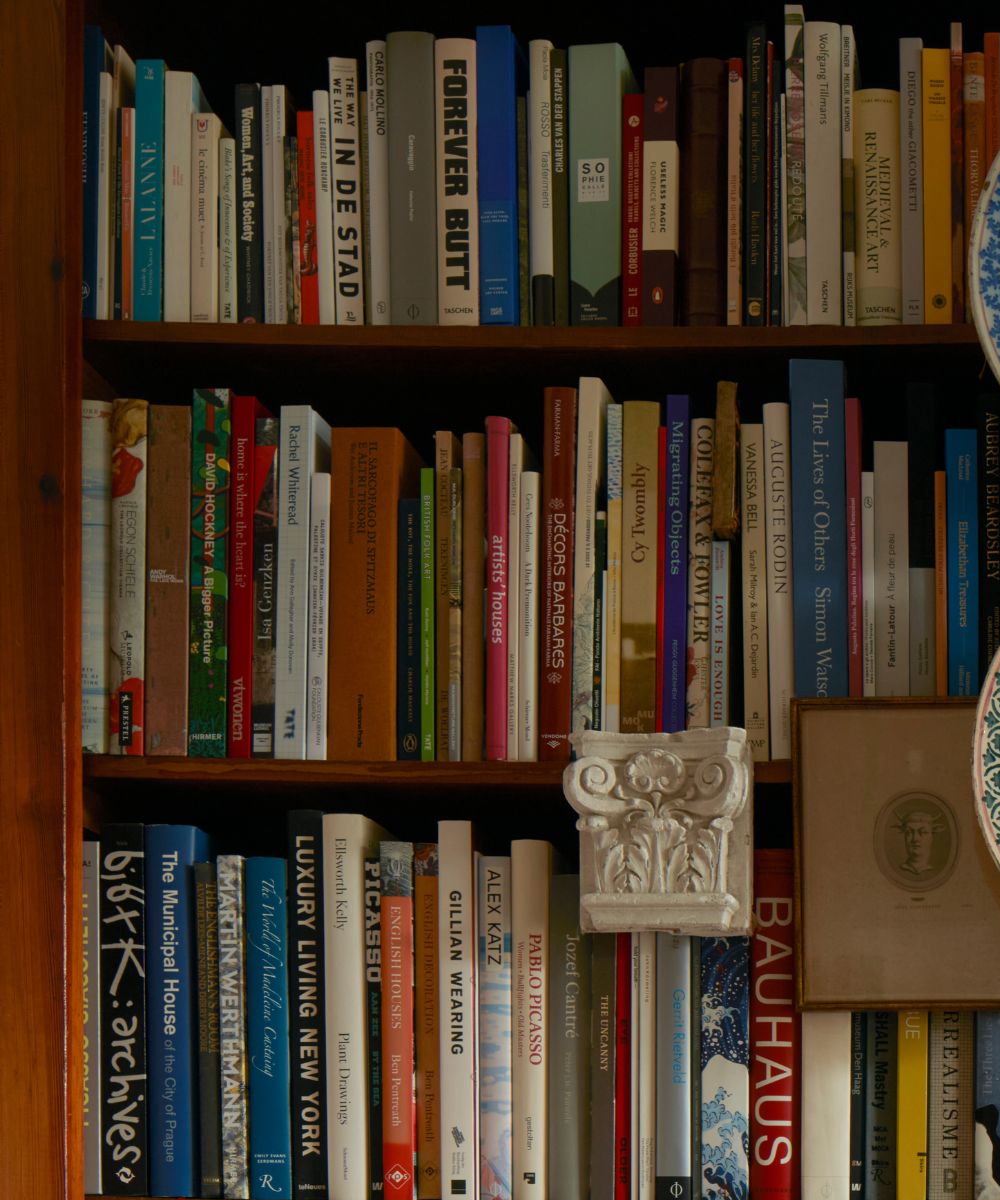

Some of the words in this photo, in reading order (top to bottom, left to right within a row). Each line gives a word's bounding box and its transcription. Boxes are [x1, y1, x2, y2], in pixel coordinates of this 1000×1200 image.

[375, 51, 384, 85] CARLO
[816, 33, 828, 80] Wolfgang
[333, 78, 342, 96] WE
[334, 100, 343, 124] LIVE
[345, 78, 354, 100] THE
[346, 103, 355, 126] WAY
[376, 89, 385, 135] MOLLINO
[820, 82, 829, 124] Tillmans
[444, 60, 468, 196] FOREVER
[540, 102, 550, 137] ROSSO
[335, 138, 355, 165] IN
[336, 180, 356, 213] DE
[864, 131, 878, 240] RENAISSANCE
[879, 156, 892, 235] MEDIEVAL
[338, 226, 359, 297] STAD
[446, 209, 470, 290] BUTT
[866, 242, 879, 273] ART
[879, 239, 890, 248] &
[288, 425, 300, 461] Rachel
[668, 421, 684, 507] Migrating
[985, 412, 999, 478] AUBREY
[205, 453, 216, 491] DAVID
[288, 467, 300, 525] Whiteread
[696, 425, 713, 527] COLEFAX
[746, 443, 757, 500] VANESSA
[770, 439, 785, 526] AUGUSTE
[204, 494, 216, 557] HOCKNEY
[552, 514, 569, 576] DÉCORS
[669, 511, 683, 575] Objects
[696, 532, 711, 546] &
[747, 504, 757, 532] BELL
[986, 484, 1000, 580] BEARDSLEY
[204, 566, 213, 577] A
[492, 535, 506, 588] artists'
[773, 534, 787, 594] RODIN
[200, 580, 213, 617] Bigger
[491, 591, 505, 644] houses
[552, 581, 566, 668] BARBARES
[693, 554, 709, 643] FOWLER
[714, 595, 723, 633] LOVE
[203, 620, 213, 663] Picture
[714, 640, 723, 654] IS
[713, 660, 723, 721] ENOUGH
[162, 851, 178, 883] The
[295, 835, 315, 930] LUXURY
[487, 870, 501, 915] ALEX
[160, 890, 178, 972] Municipal
[219, 872, 239, 964] MARTIN
[364, 862, 382, 982] PICASSO
[390, 905, 401, 970] ENGLISH
[449, 890, 462, 961] GILLIAN
[487, 923, 501, 965] KATZ
[297, 940, 317, 1018] LIVING
[529, 934, 542, 989] PABLO
[164, 979, 180, 1035] House
[390, 974, 402, 1028] HOUSES
[450, 972, 463, 1055] WEARING
[600, 995, 608, 1016] THE
[222, 970, 241, 1127] WERTHMANN
[299, 1028, 319, 1082] NEW
[529, 994, 543, 1065] PICASSO
[599, 1019, 608, 1071] UNCANNY
[755, 897, 792, 1166] BAUHAUS
[301, 1092, 320, 1156] YORK
